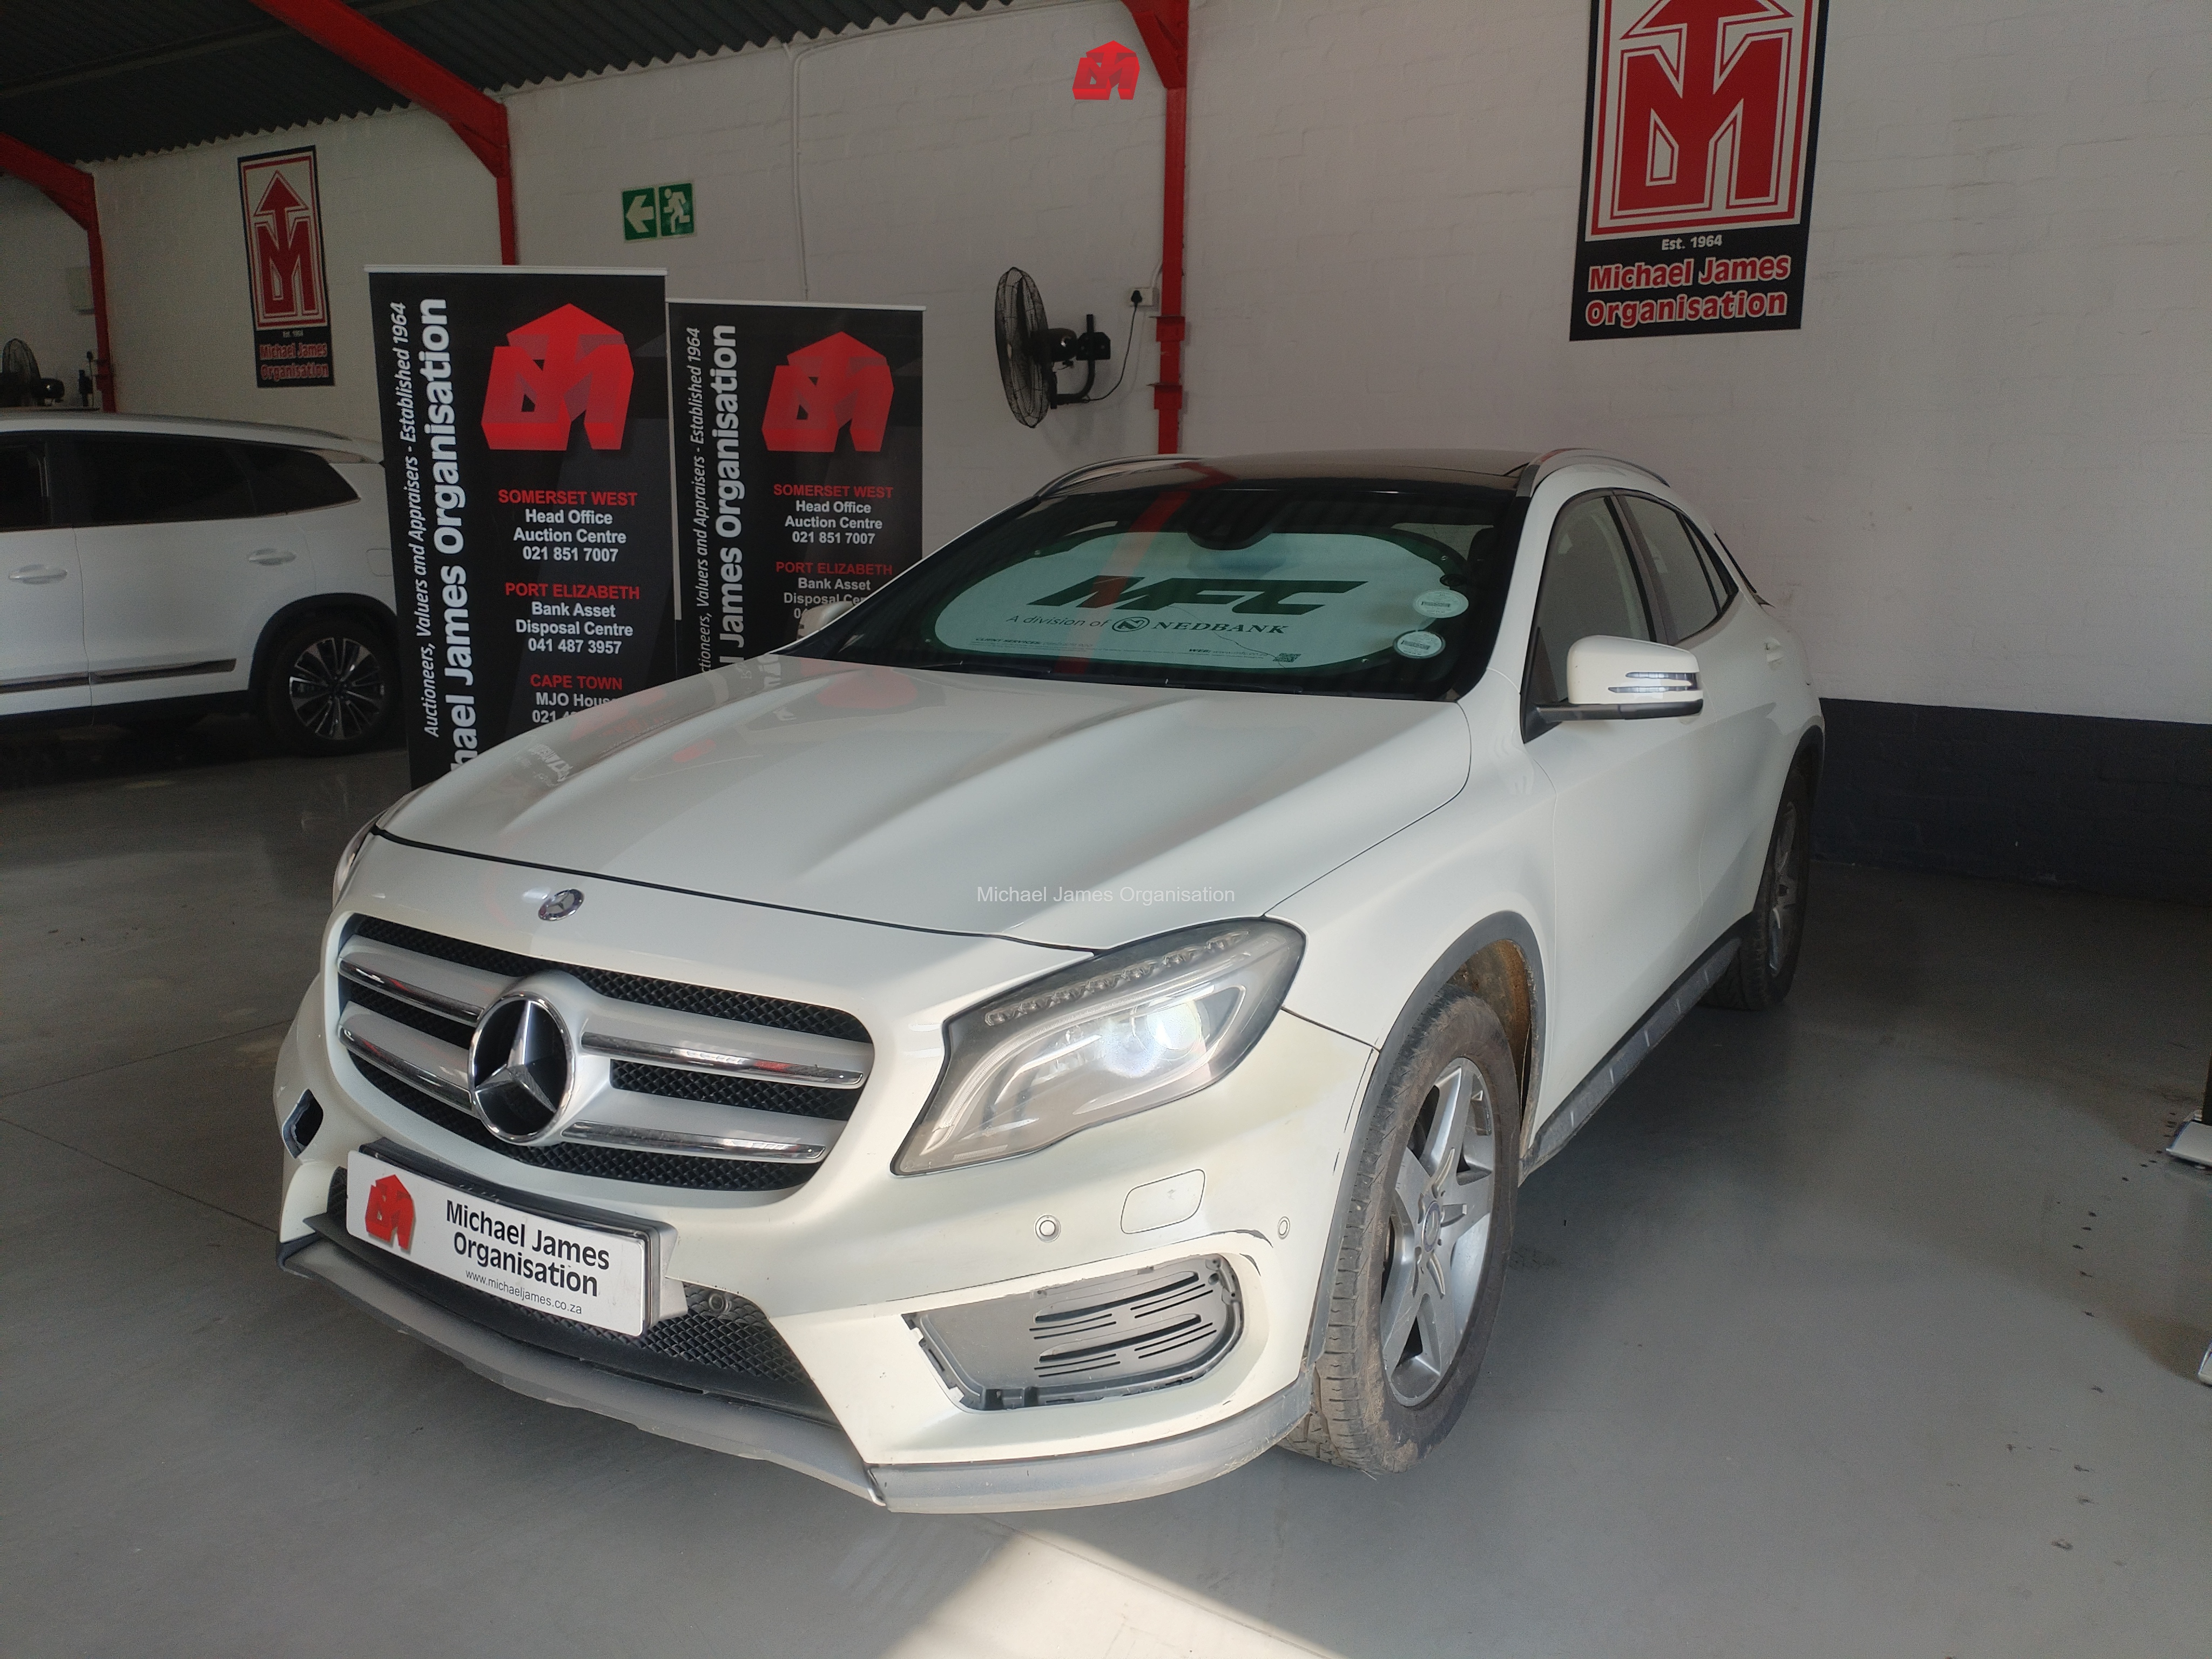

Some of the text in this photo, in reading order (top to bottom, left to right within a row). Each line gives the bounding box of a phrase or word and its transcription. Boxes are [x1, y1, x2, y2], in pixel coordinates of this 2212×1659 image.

[1662, 234, 1723, 251] Est. 1964
[1588, 255, 1791, 292] Michael James
[1586, 289, 1788, 328] Organisation
[390, 302, 408, 344] 1964
[686, 327, 701, 362] 1964
[392, 347, 416, 442] Established
[686, 365, 704, 444] Established
[710, 325, 745, 538] Organisation
[403, 456, 427, 542] Appraisers
[498, 489, 638, 506] SOMERSET WEST
[691, 455, 709, 527] Appraisers
[773, 484, 893, 498] SOMERSET WEST
[525, 509, 613, 525] Head Office
[795, 500, 871, 514] Head Office
[785, 515, 883, 529] Auction Centre
[419, 299, 478, 771] hael James Organisation
[514, 527, 626, 544] Auction Centre
[693, 529, 708, 556] and
[792, 531, 875, 544] 021 851 7007
[408, 543, 427, 576] and
[522, 545, 618, 562] 021 851 7007
[775, 562, 893, 575] PORT ELIZABETH
[504, 582, 640, 599] PORT ELIZABETH
[695, 558, 710, 606] Valuers
[798, 577, 871, 591] Bank Asset
[720, 547, 744, 648] James
[784, 592, 839, 605] Disposal
[1027, 575, 1368, 616] MFC
[414, 579, 431, 636] Valuers
[531, 601, 616, 618] Bank Asset
[515, 619, 633, 636] Disposal Centre
[1023, 616, 1085, 626] division
[1089, 619, 1112, 627] of
[1151, 622, 1289, 634] NEDBANK
[528, 638, 622, 655] 041 487 3957
[421, 643, 439, 738] Auctioneers,
[530, 674, 623, 690] CAPE TOWN
[536, 692, 616, 707] MJO Hous
[532, 710, 556, 723] 021
[447, 1199, 610, 1270] Michael James
[454, 1231, 598, 1297] Organisation
[466, 1270, 582, 1314] www.michaeljames.co.za
